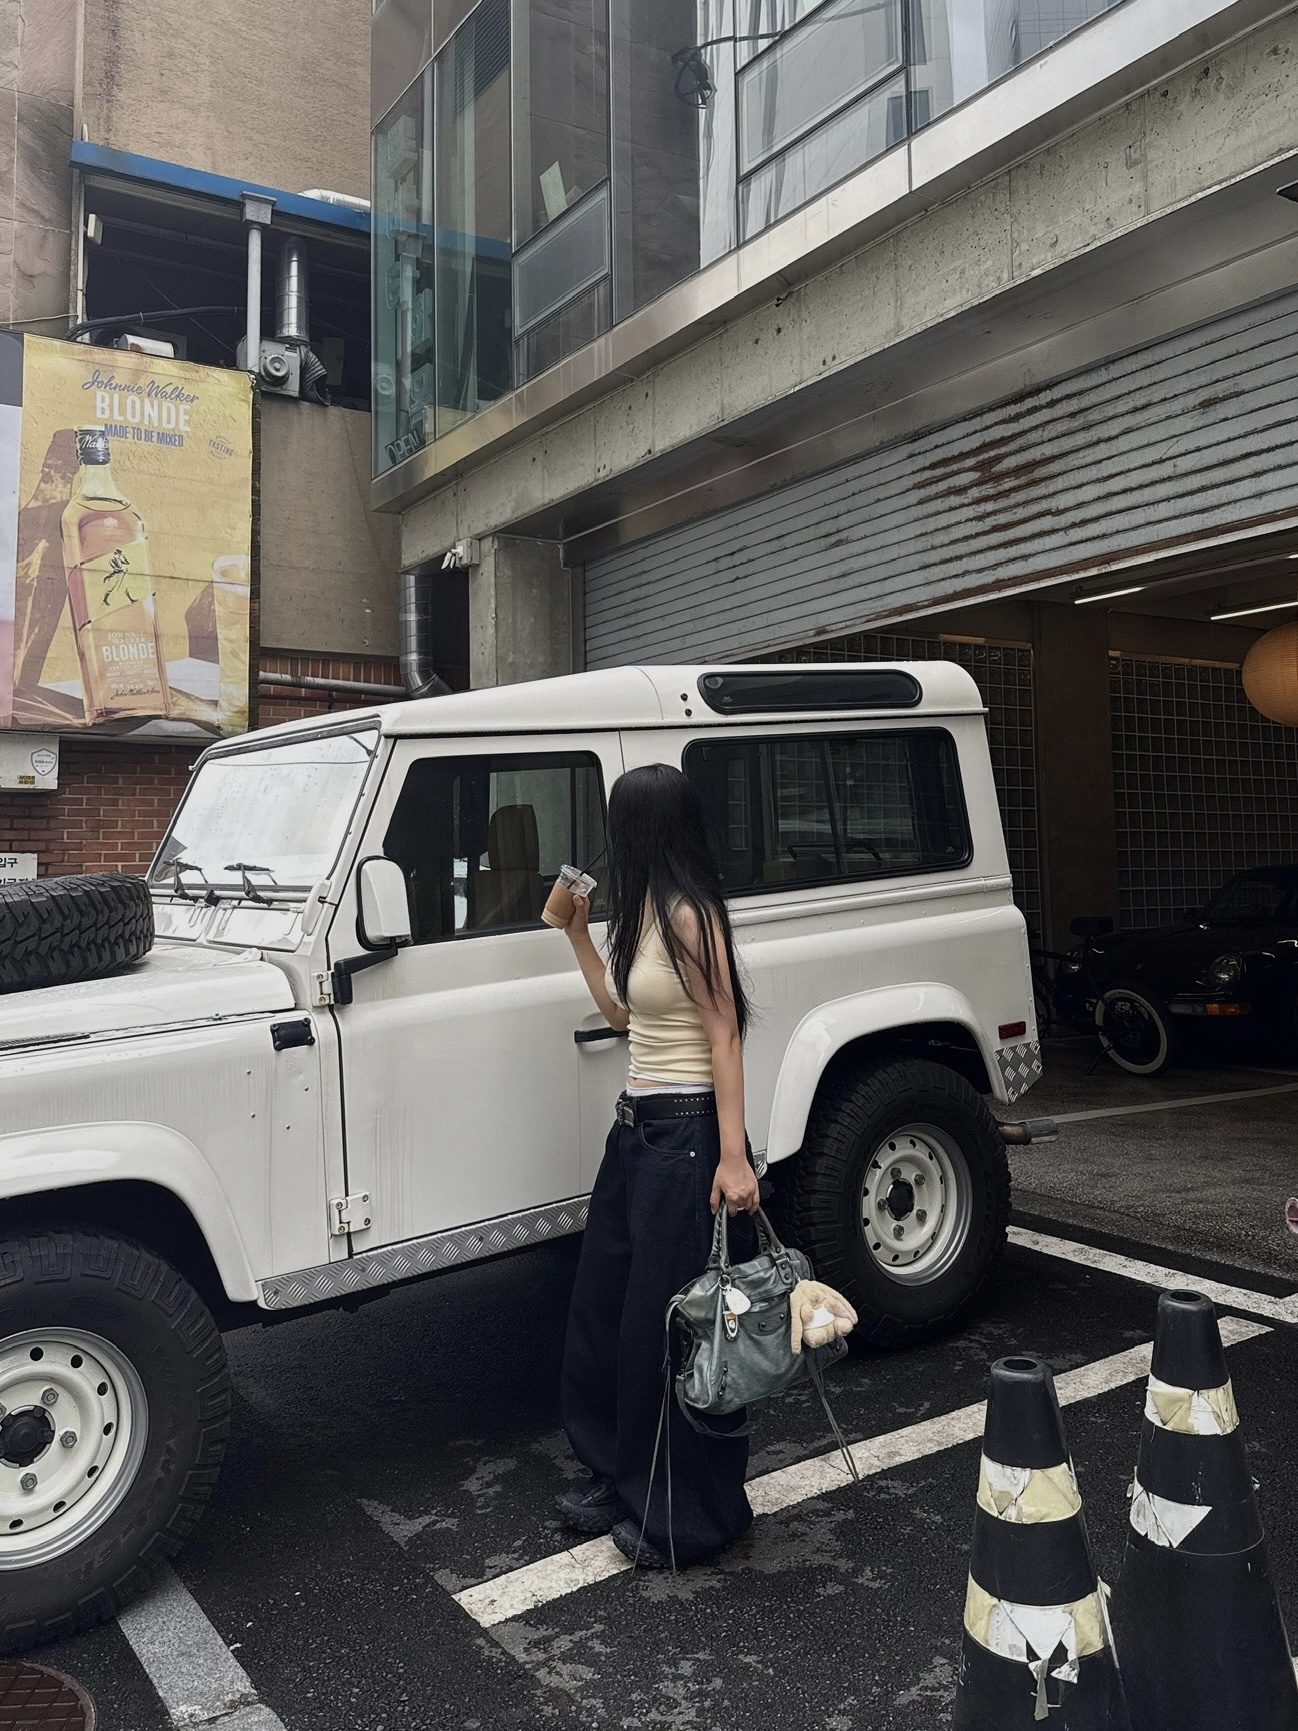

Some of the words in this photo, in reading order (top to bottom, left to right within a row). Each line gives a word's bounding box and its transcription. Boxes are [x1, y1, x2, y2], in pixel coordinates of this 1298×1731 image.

[82, 369, 144, 394] Johnnie
[147, 380, 199, 404] Walker
[96, 390, 191, 432] BLONDE
[104, 423, 129, 439] MADE
[131, 425, 143, 441] TO
[144, 427, 155, 443] BE
[156, 429, 184, 448] MIXED
[208, 439, 235, 457] TASTING
[386, 430, 420, 465] OPEN
[102, 643, 156, 662] BLONDE
